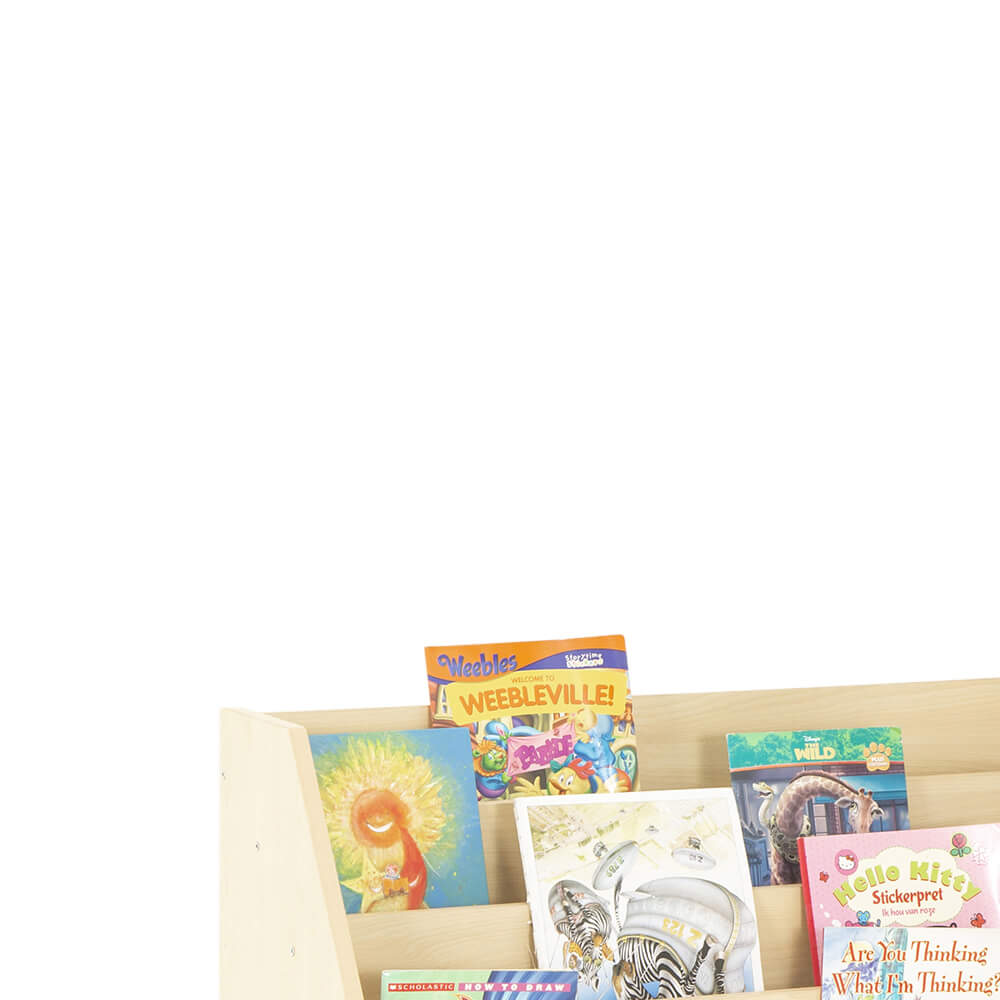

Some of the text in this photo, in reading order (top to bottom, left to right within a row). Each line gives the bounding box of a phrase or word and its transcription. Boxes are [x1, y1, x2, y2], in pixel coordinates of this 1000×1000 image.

[437, 653, 518, 679] Weebles
[511, 675, 544, 684] WELCOME
[459, 684, 615, 716] WEEBLEVILLE!
[794, 743, 836, 760] WILD
[832, 861, 983, 908] Hello Kitty
[872, 887, 944, 908] Stickerpret
[890, 906, 904, 917] hou
[841, 940, 989, 967] Are You Thinking
[397, 983, 565, 991] SCHOLASTIC HOW TO DRAW
[832, 973, 884, 995] What
[886, 973, 914, 994] I'm
